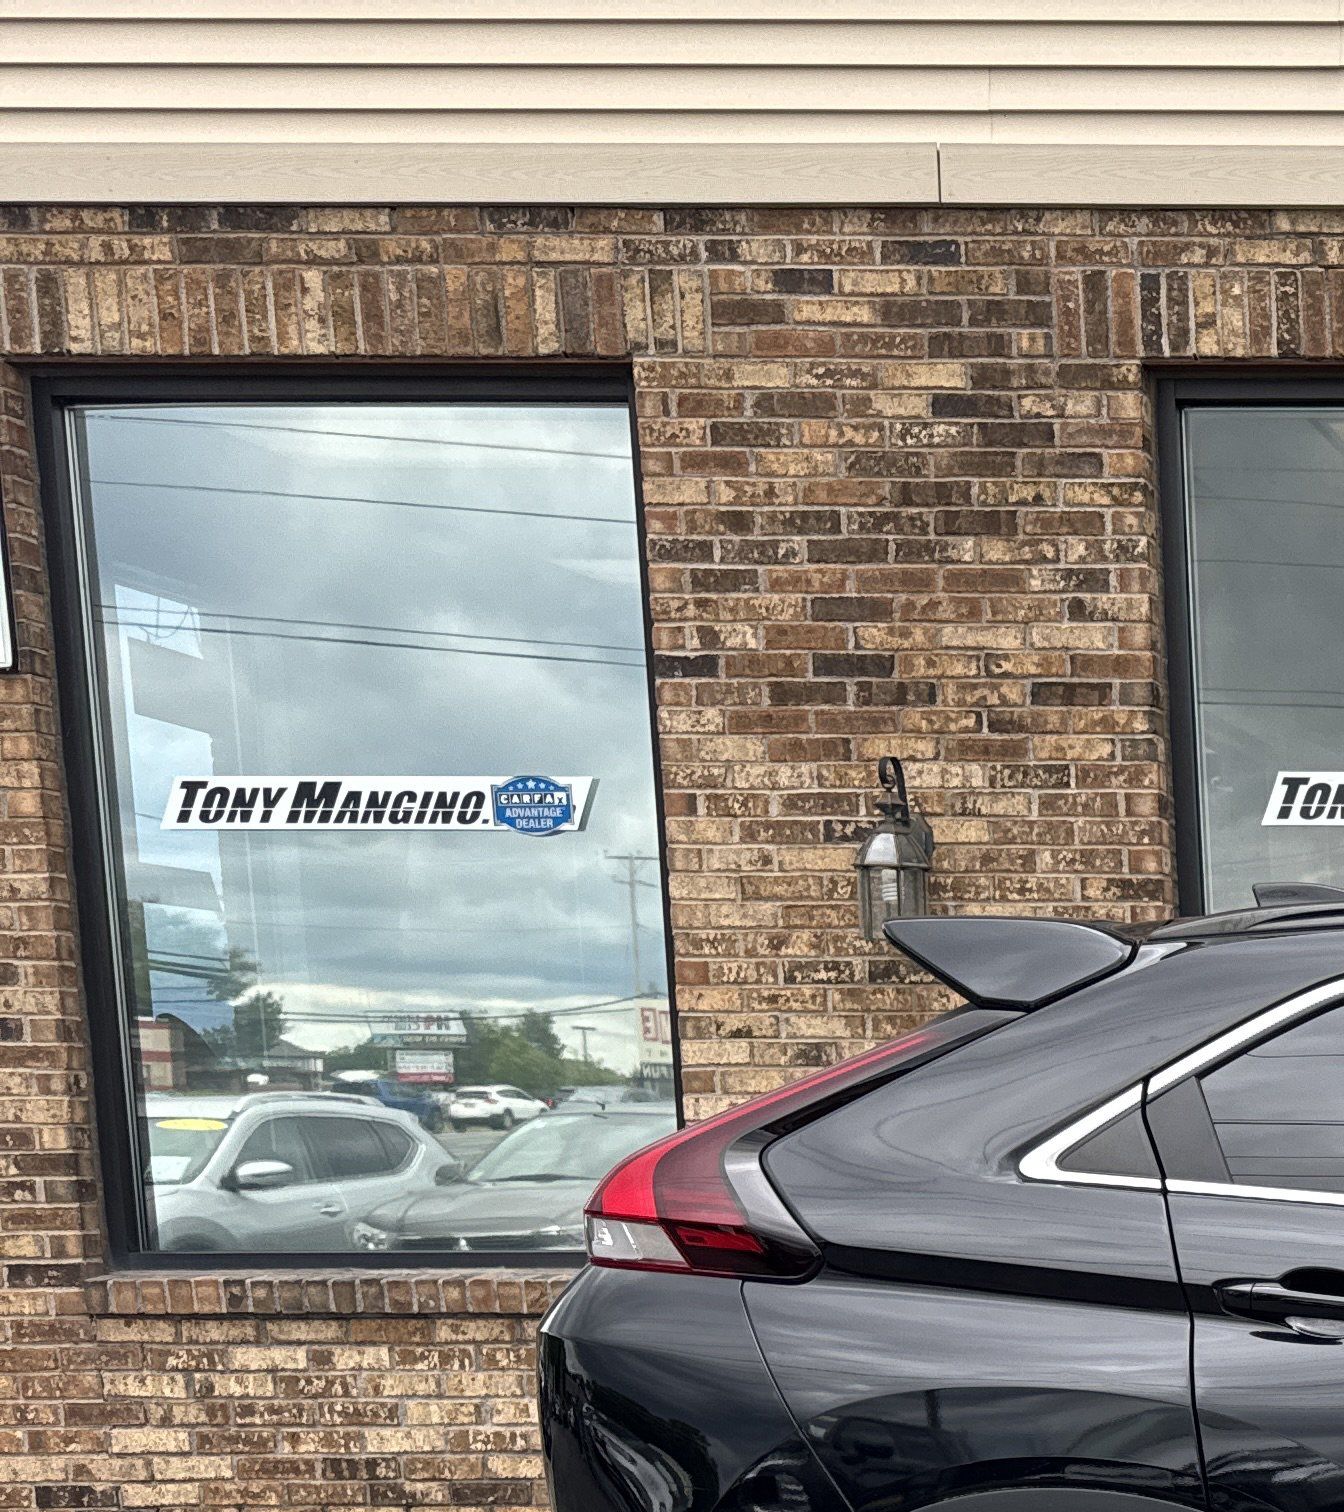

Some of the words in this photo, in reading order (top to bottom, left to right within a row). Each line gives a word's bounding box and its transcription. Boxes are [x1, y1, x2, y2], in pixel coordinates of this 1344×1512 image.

[176, 781, 288, 823] TONY
[499, 792, 567, 805] CARFAX
[516, 817, 554, 829] DEALER
